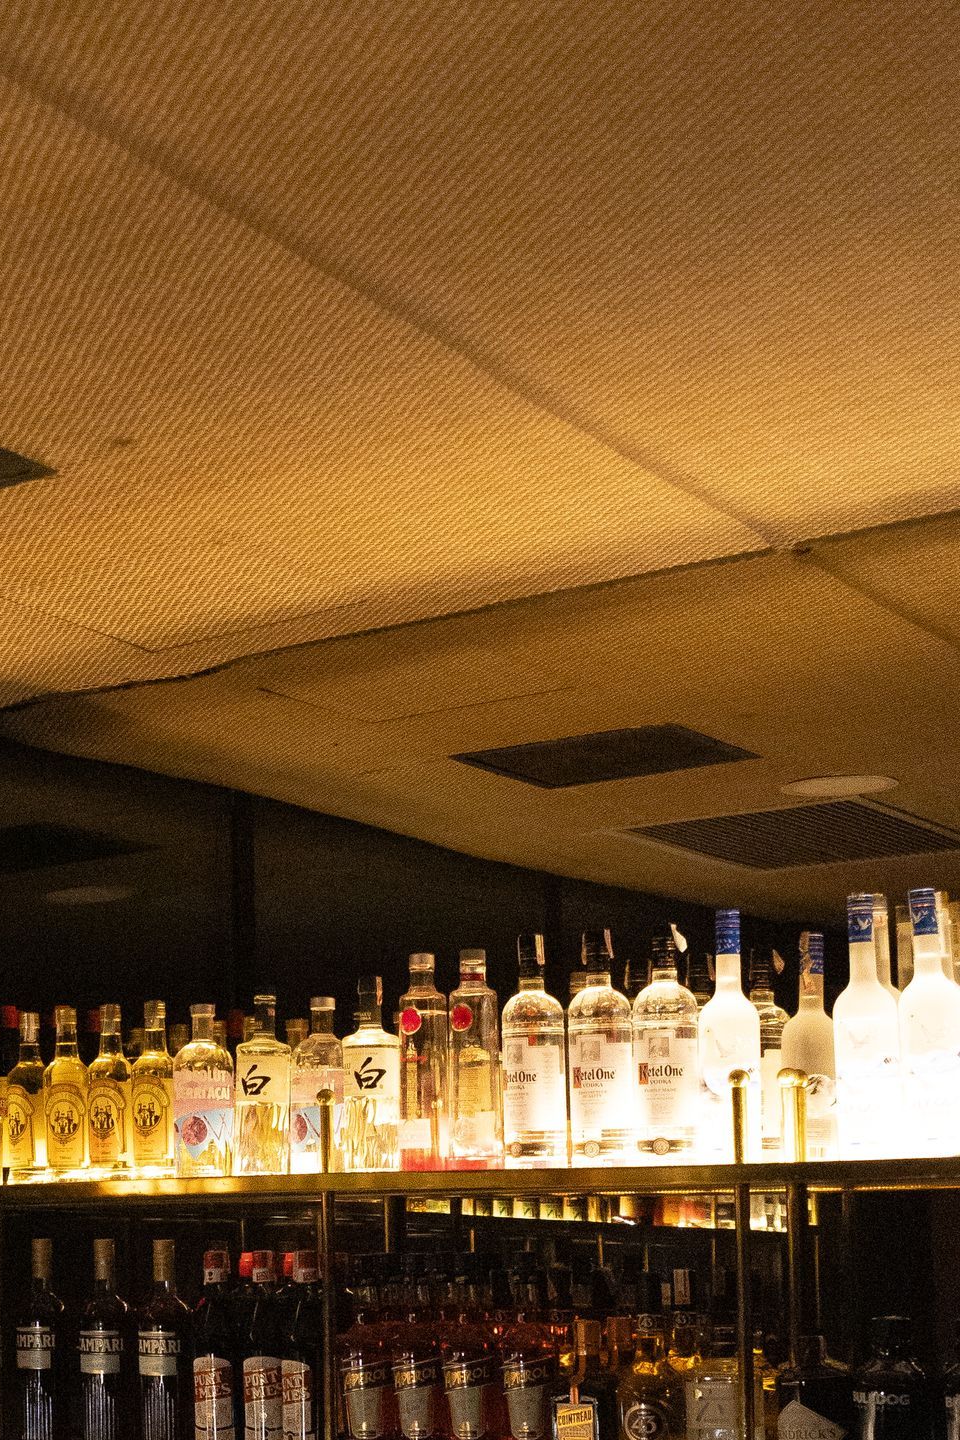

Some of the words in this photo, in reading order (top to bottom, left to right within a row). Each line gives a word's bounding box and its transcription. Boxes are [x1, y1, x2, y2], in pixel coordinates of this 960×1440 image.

[241, 1064, 272, 1096] 白
[354, 1056, 386, 1091] 白
[596, 1068, 616, 1081] One
[664, 1065, 683, 1077] One
[631, 1414, 658, 1434] 43
